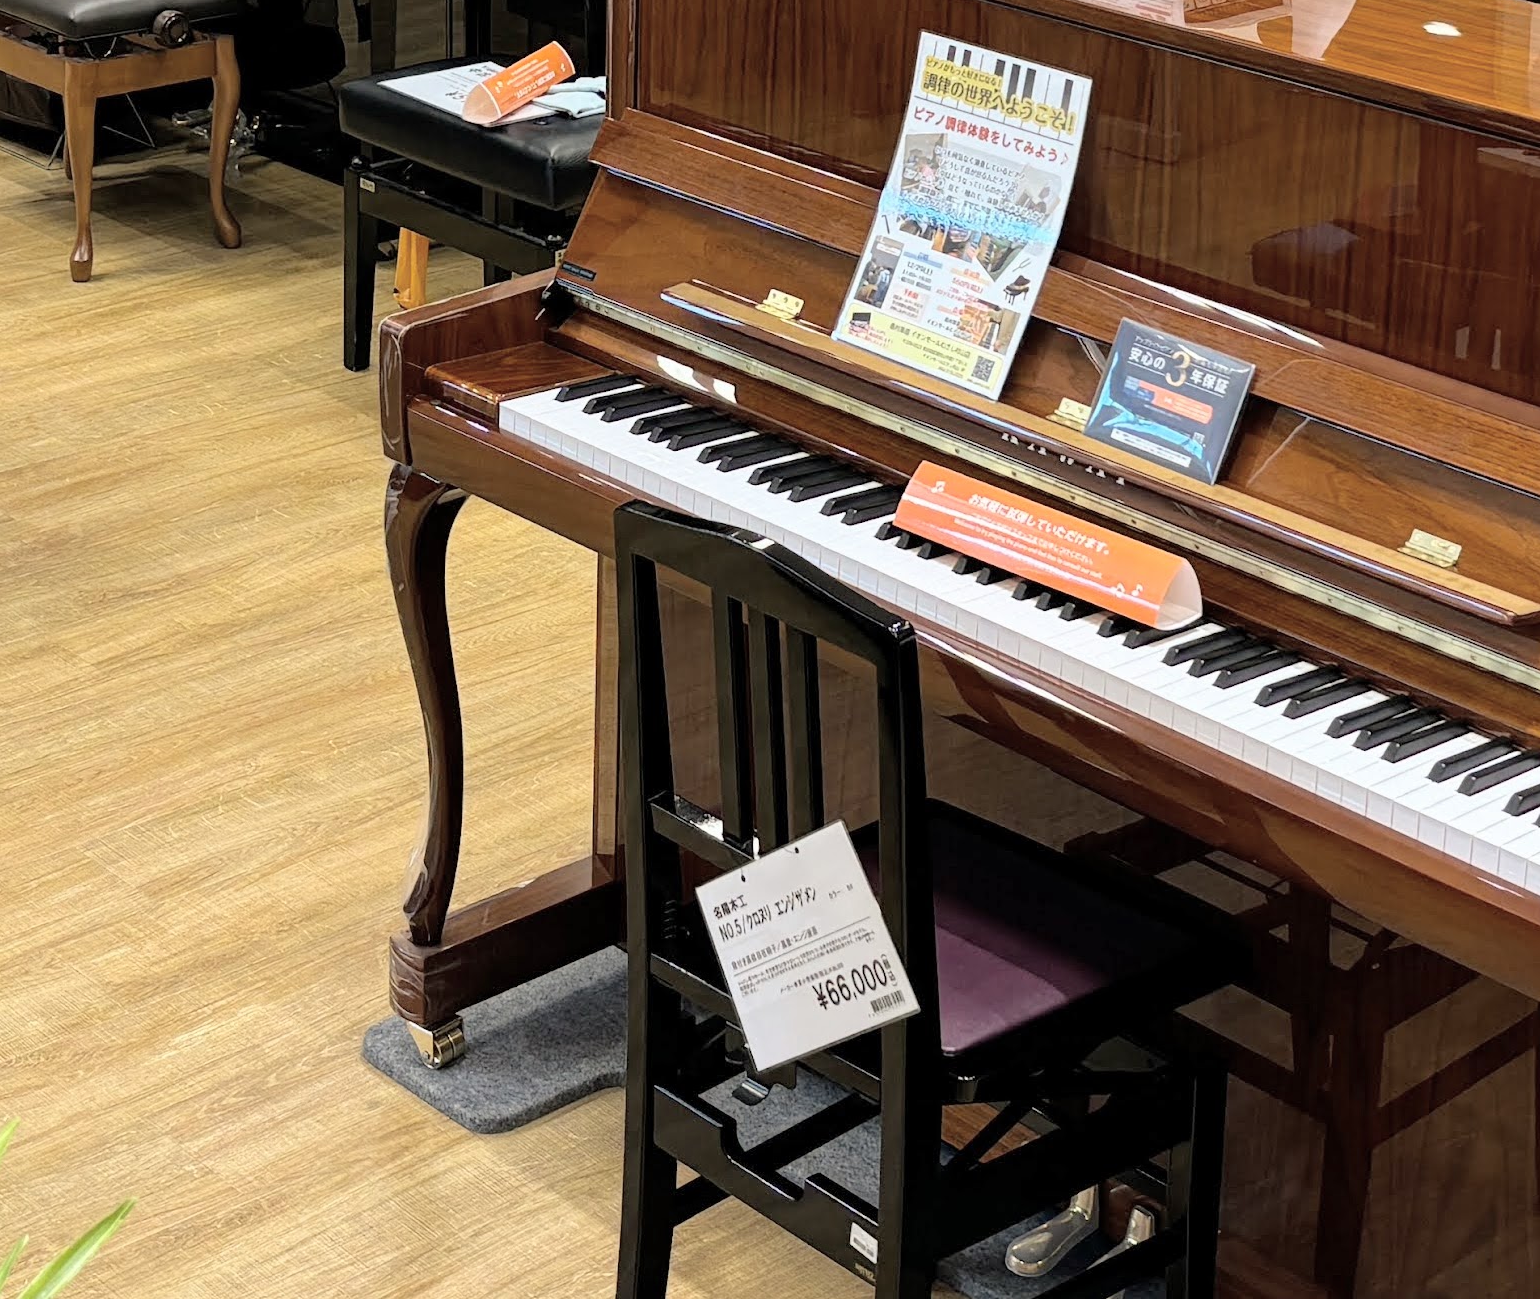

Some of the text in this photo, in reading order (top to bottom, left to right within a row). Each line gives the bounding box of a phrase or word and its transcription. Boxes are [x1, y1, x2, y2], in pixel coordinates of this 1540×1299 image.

[922, 71, 1075, 134] 調律の世界へようこそ！
[1129, 348, 1230, 394] 安心の3年保証
[812, 959, 888, 1010] ¥66,000
